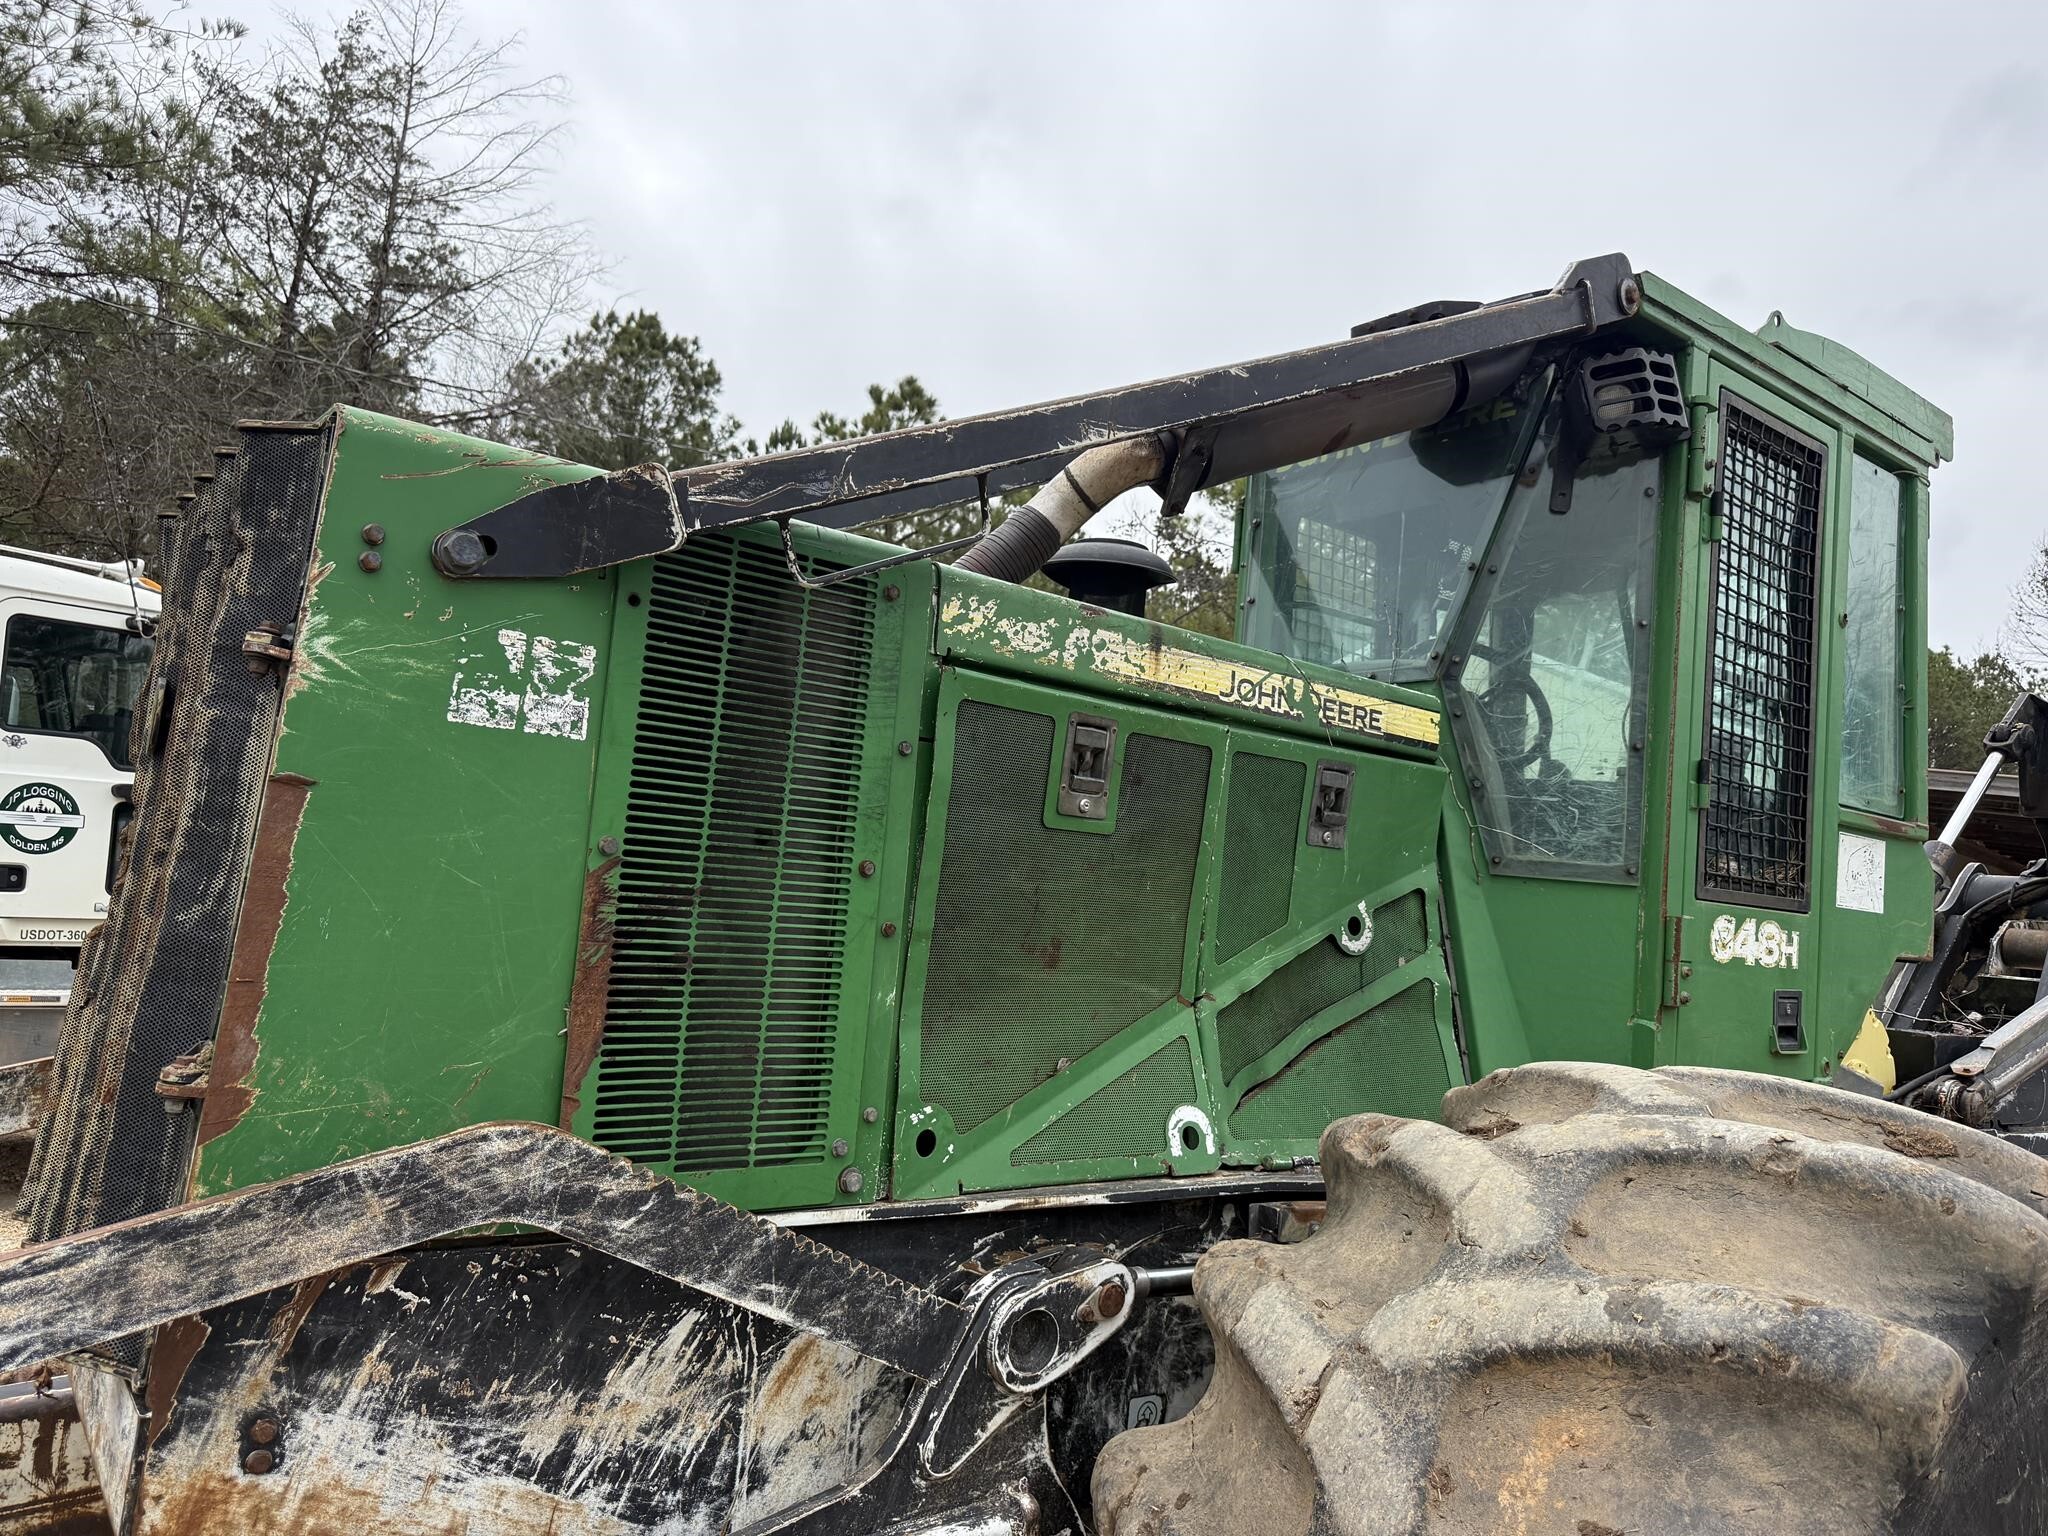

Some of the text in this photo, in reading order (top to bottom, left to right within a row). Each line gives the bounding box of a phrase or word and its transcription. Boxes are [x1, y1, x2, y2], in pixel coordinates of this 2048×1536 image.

[5, 786, 73, 812] JP LOGGING
[51, 835, 65, 849] MS
[20, 929, 87, 940] USDOT-360
